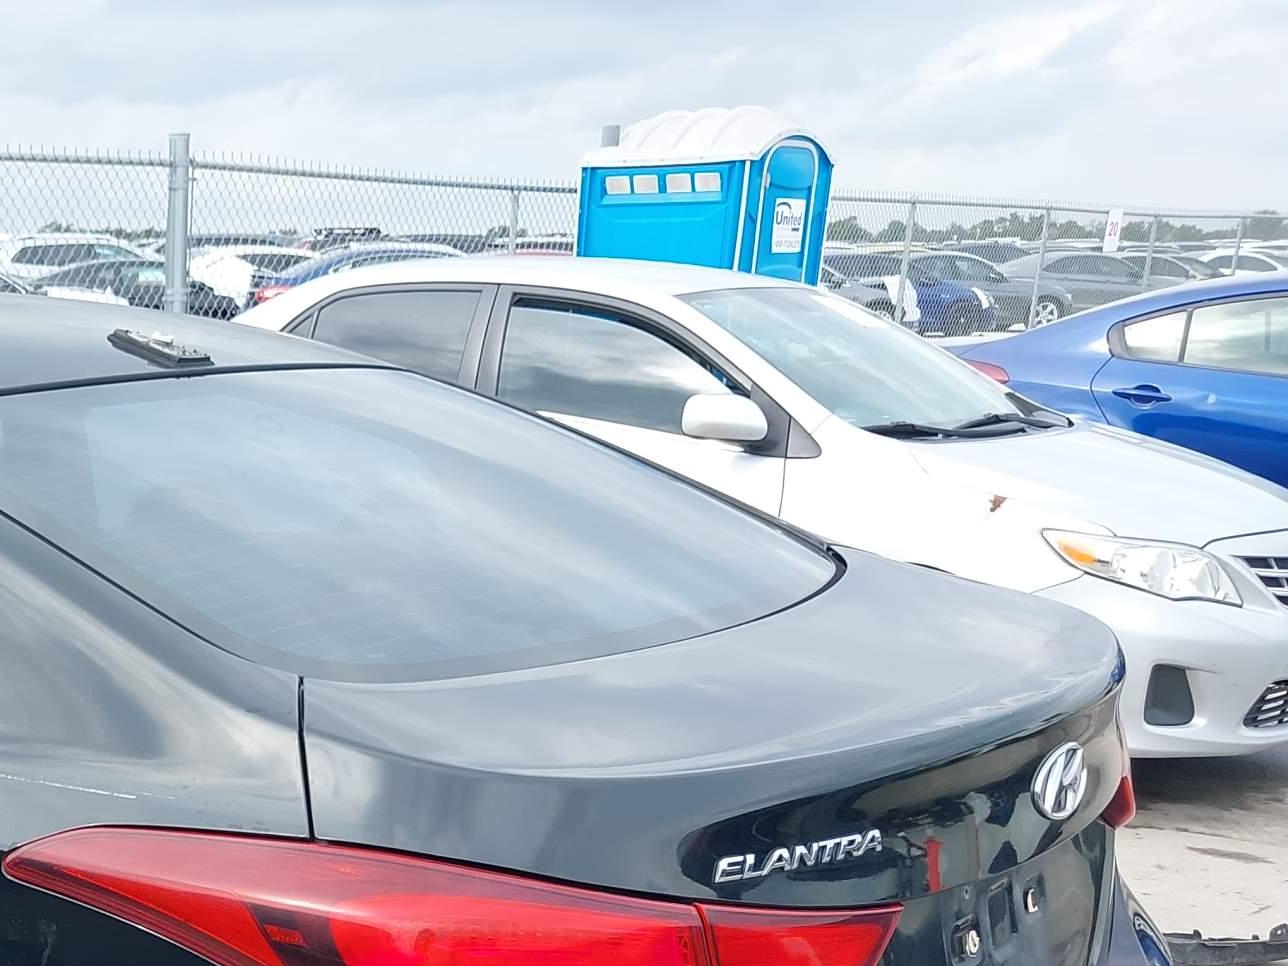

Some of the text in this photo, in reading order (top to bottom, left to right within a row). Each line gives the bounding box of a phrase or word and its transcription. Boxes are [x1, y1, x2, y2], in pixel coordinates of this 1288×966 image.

[776, 210, 803, 226] United
[1108, 221, 1119, 237] 20
[714, 829, 883, 883] ELANTRA
